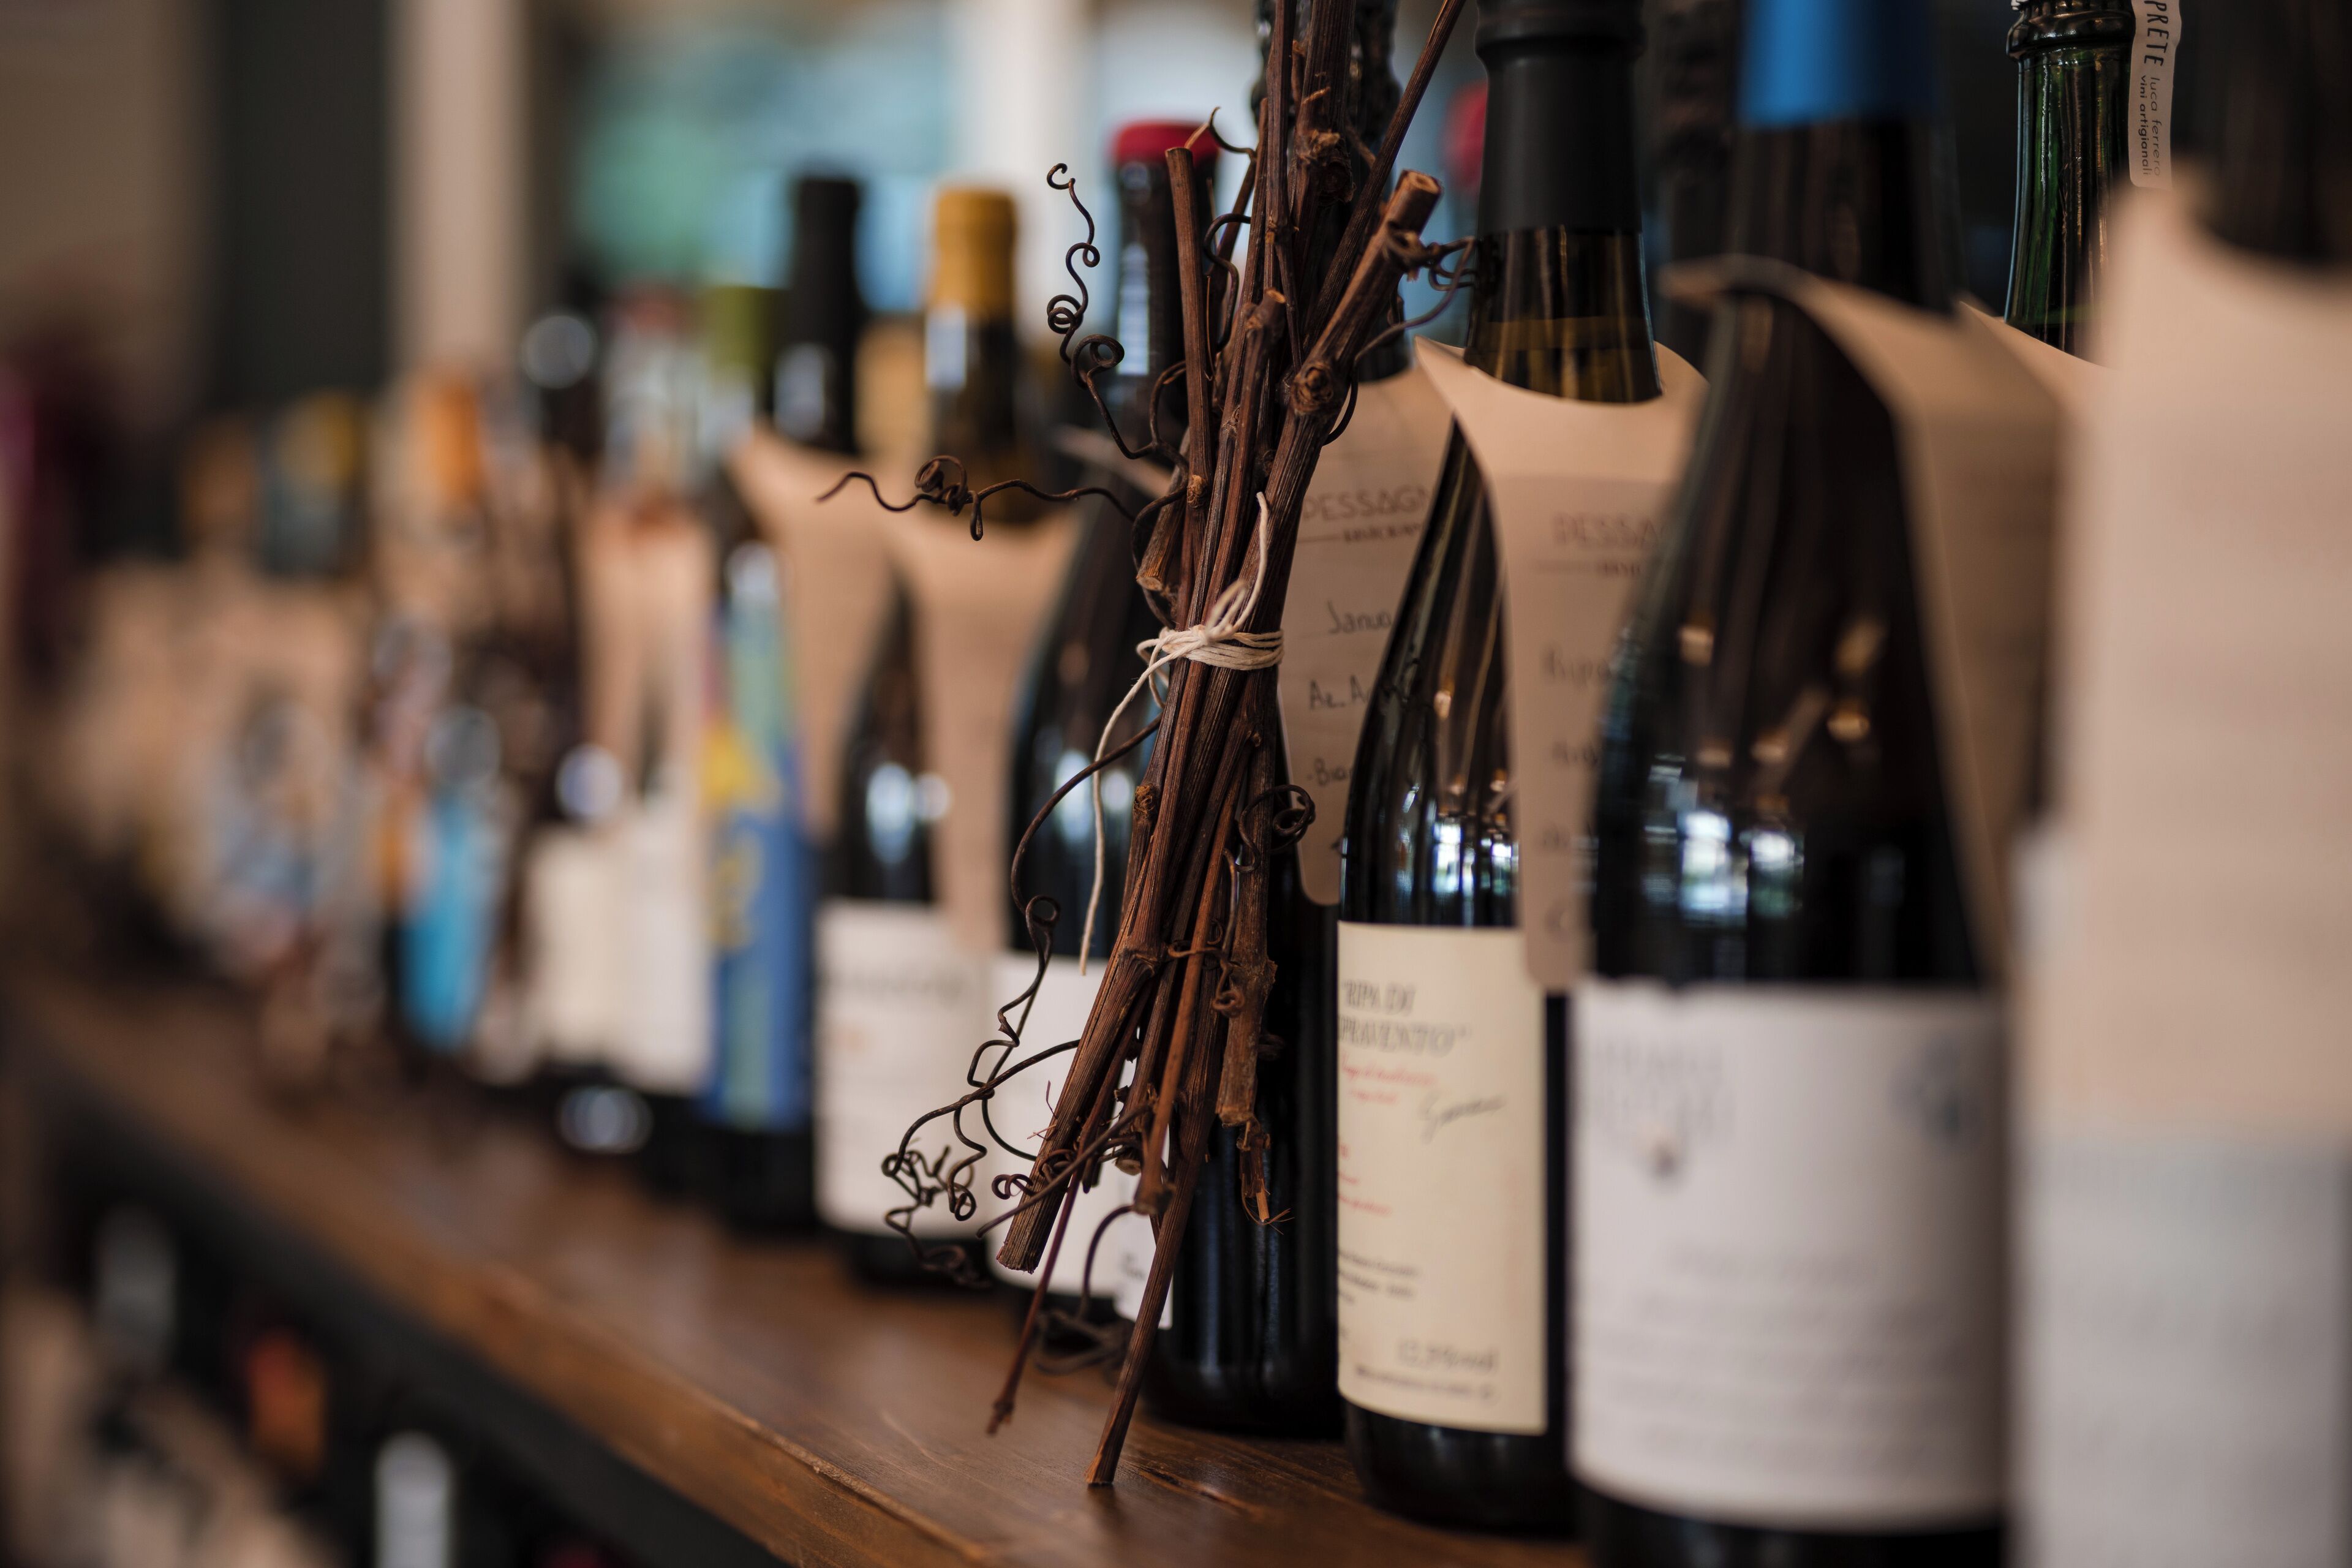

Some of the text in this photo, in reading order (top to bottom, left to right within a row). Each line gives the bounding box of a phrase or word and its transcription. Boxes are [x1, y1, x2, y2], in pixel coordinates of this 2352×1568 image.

[2138, 104, 2152, 176] artigianali
[2150, 77, 2162, 177] luca ferrero
